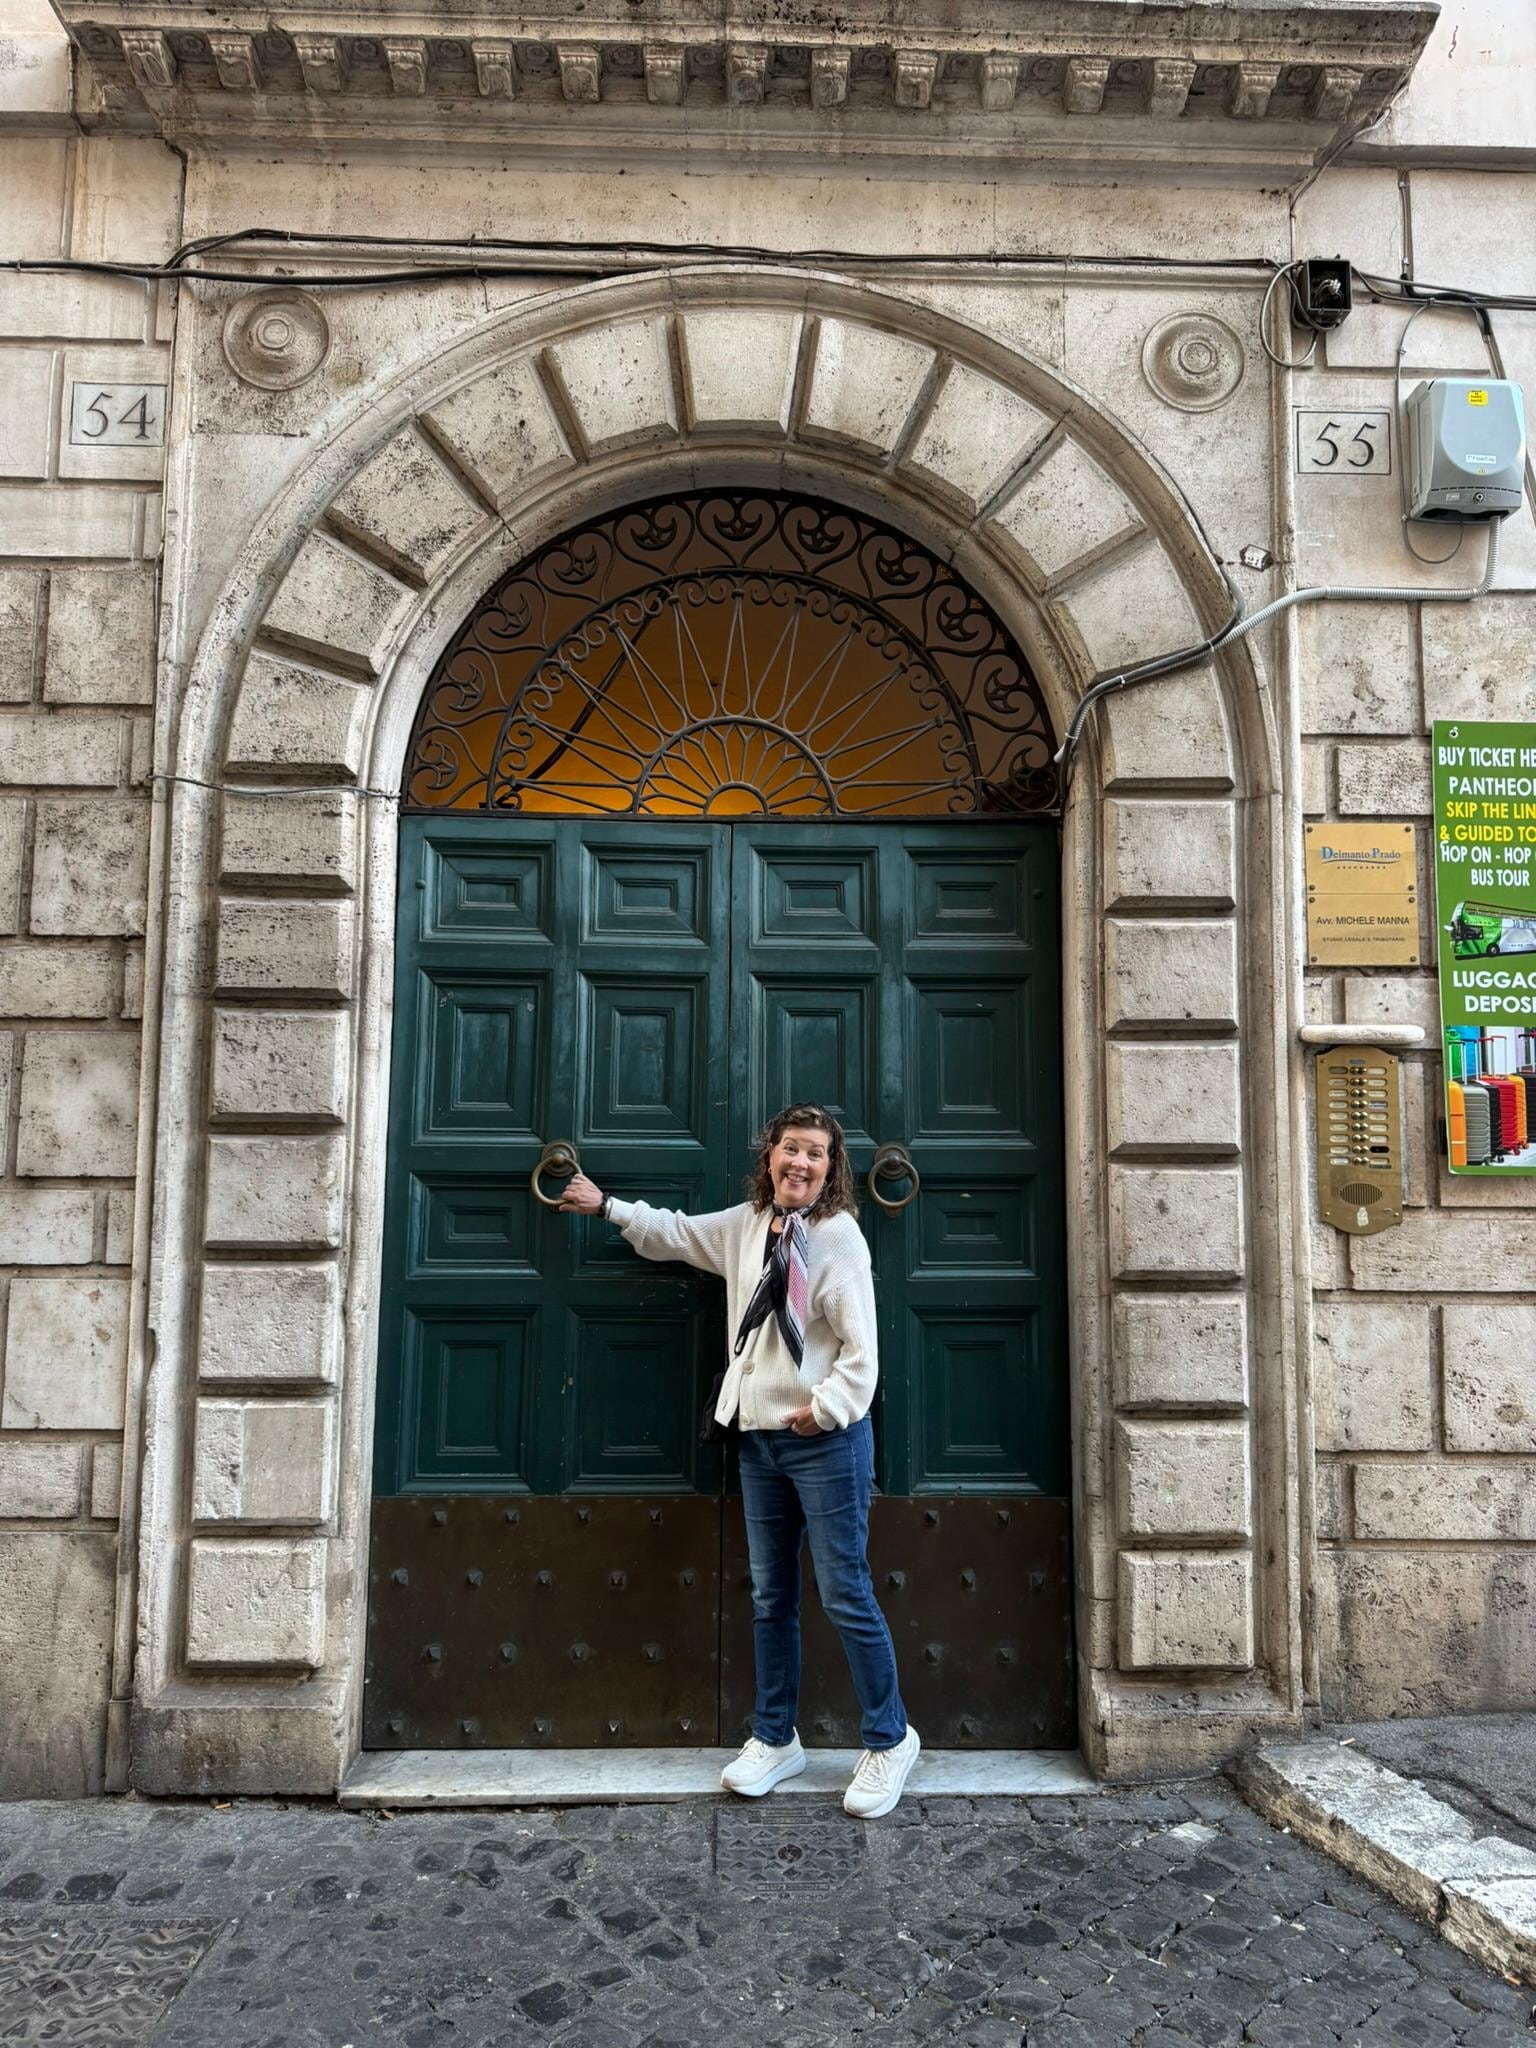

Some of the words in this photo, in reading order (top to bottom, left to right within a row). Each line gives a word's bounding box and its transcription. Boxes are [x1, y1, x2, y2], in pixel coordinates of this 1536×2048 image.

[81, 391, 156, 439] 54
[1311, 421, 1377, 467] 55
[1438, 746, 1466, 766] BUY
[1469, 747, 1516, 767] TICKET
[1449, 776, 1536, 796] PANTHEO
[1446, 801, 1478, 818] SKIP
[1481, 802, 1509, 819] THE
[1513, 803, 1536, 819] LIN
[1440, 825, 1450, 840] &
[1455, 824, 1514, 842] GUIDED
[1517, 825, 1536, 842] TO
[1321, 846, 1370, 859] Delmanto
[1372, 847, 1401, 859] Prado
[1441, 845, 1468, 863] HOP
[1471, 846, 1492, 864] ON
[1504, 847, 1532, 864] HOP
[1471, 868, 1494, 886] BUS
[1496, 869, 1531, 887] TOUR
[1316, 916, 1333, 925] Avv.
[1336, 916, 1375, 925] MICHELE
[1377, 916, 1410, 925] MANNA
